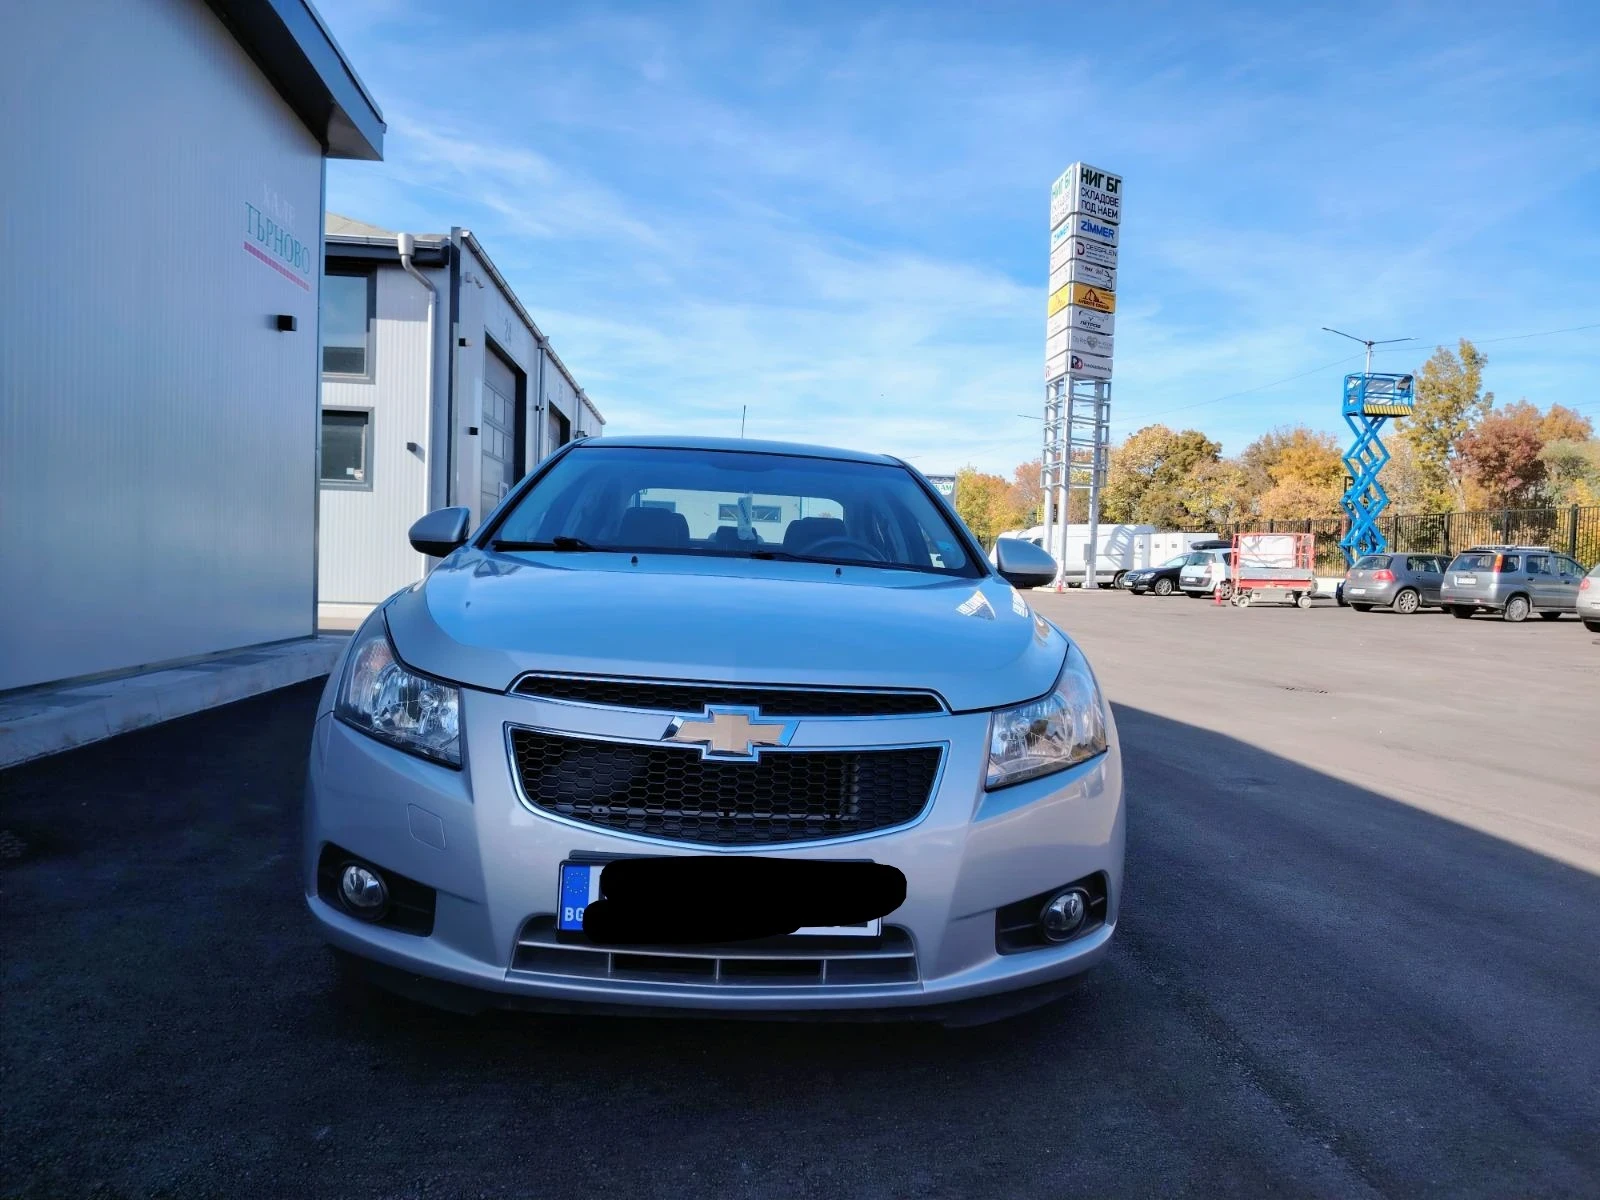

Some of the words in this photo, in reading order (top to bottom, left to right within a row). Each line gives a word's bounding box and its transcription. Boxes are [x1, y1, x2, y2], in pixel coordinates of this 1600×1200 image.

[1081, 168, 1104, 189] НИГ
[1106, 176, 1122, 194] БГ
[1081, 187, 1119, 208] СКЛАДОВЕ
[1081, 200, 1097, 214] ПОД
[1097, 205, 1118, 219] НАЕМ
[245, 201, 310, 274] ТЪРНОВО
[564, 907, 584, 922] BG
